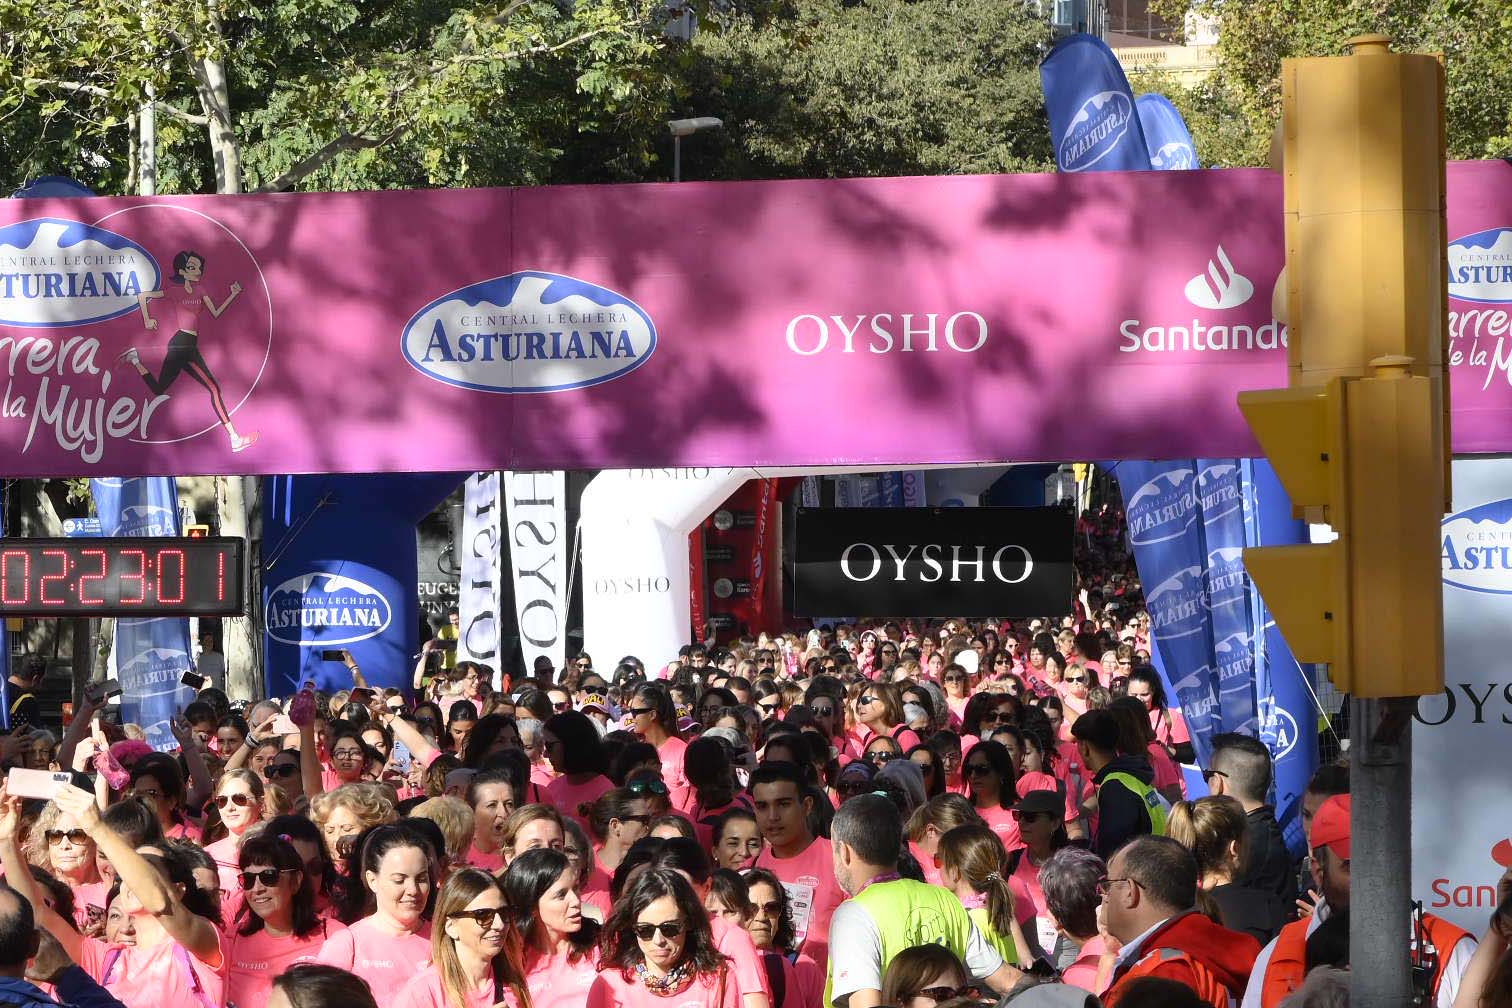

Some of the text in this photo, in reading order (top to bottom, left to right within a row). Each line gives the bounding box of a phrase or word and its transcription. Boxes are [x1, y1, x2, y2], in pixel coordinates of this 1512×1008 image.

[63, 254, 137, 267] LECHERA
[460, 312, 628, 327] CENTRAL LECHERA
[785, 311, 988, 355] OYSHO
[1119, 318, 1288, 353] Santand
[1448, 309, 1512, 338] arre
[421, 318, 637, 363] ASTURIANA
[1, 381, 27, 419] la
[21, 372, 172, 464] Mujer
[840, 542, 1034, 586] OYSHO
[1441, 535, 1512, 572] ASTU
[1, 550, 225, 604] 02:23:01
[417, 582, 459, 595] EUGE
[594, 576, 671, 594] OYSHO
[269, 602, 382, 629] ASTURIANA
[1431, 878, 1496, 908] San
